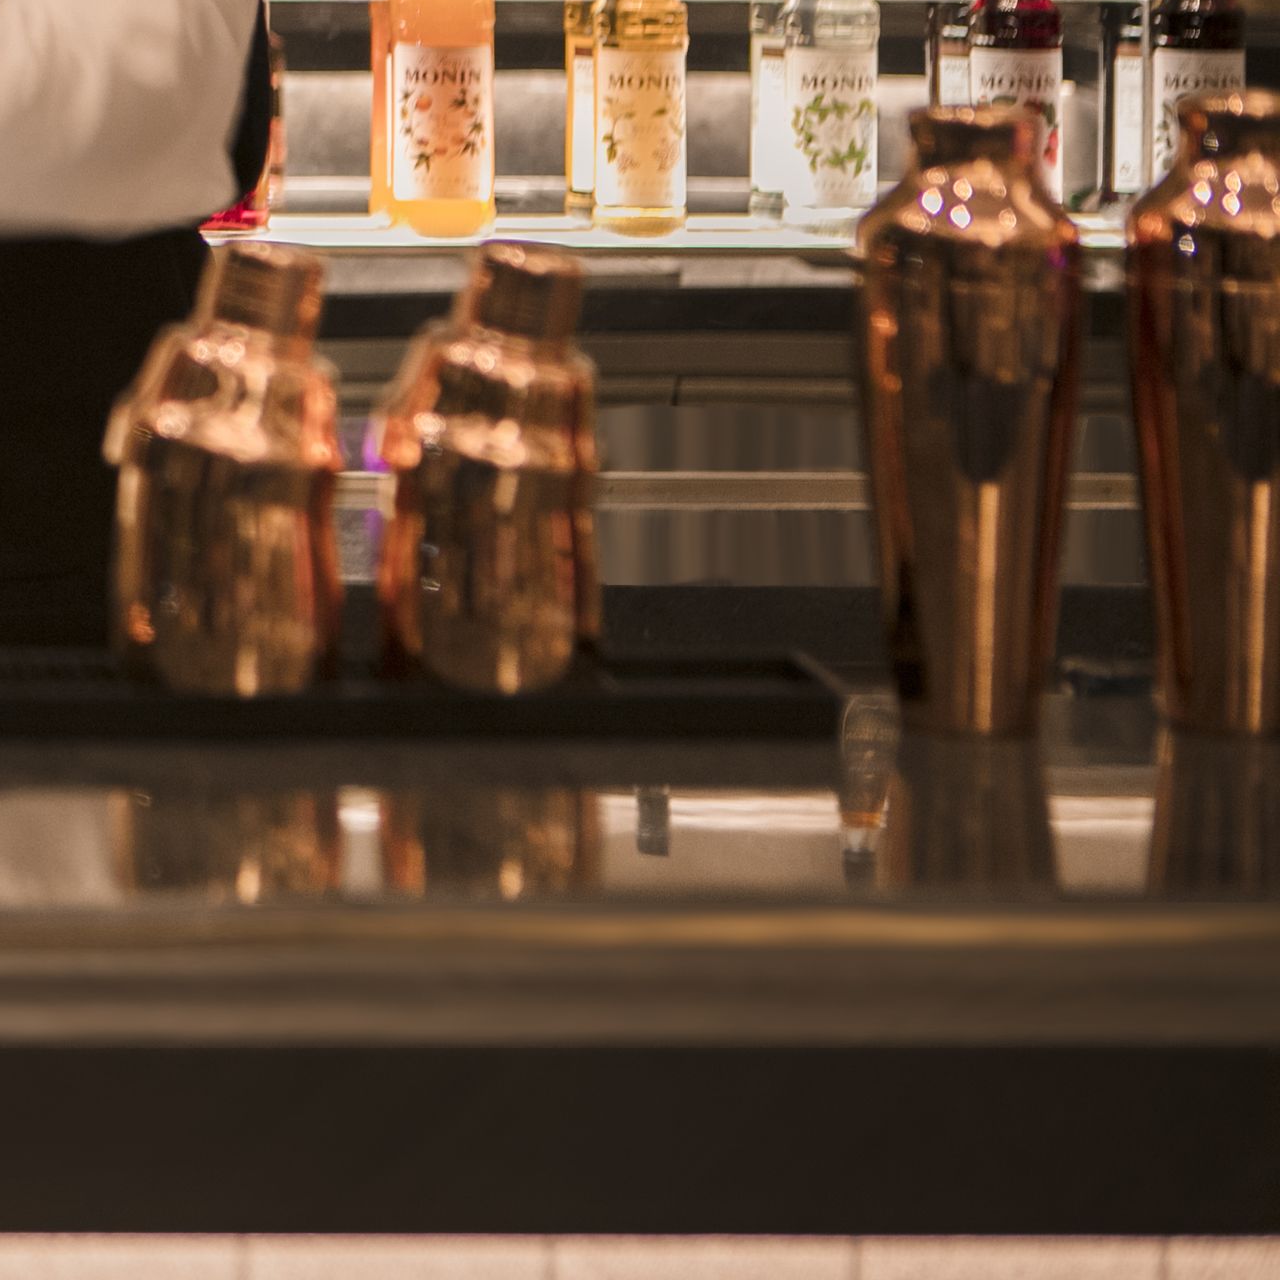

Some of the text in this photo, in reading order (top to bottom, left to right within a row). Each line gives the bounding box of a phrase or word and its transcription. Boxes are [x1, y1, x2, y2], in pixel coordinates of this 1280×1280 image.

[405, 69, 482, 83] MONIN
[608, 74, 681, 89] MONIN
[801, 74, 875, 91] MONIN
[980, 74, 1055, 90] MONIN
[1164, 73, 1241, 90] MONIN
